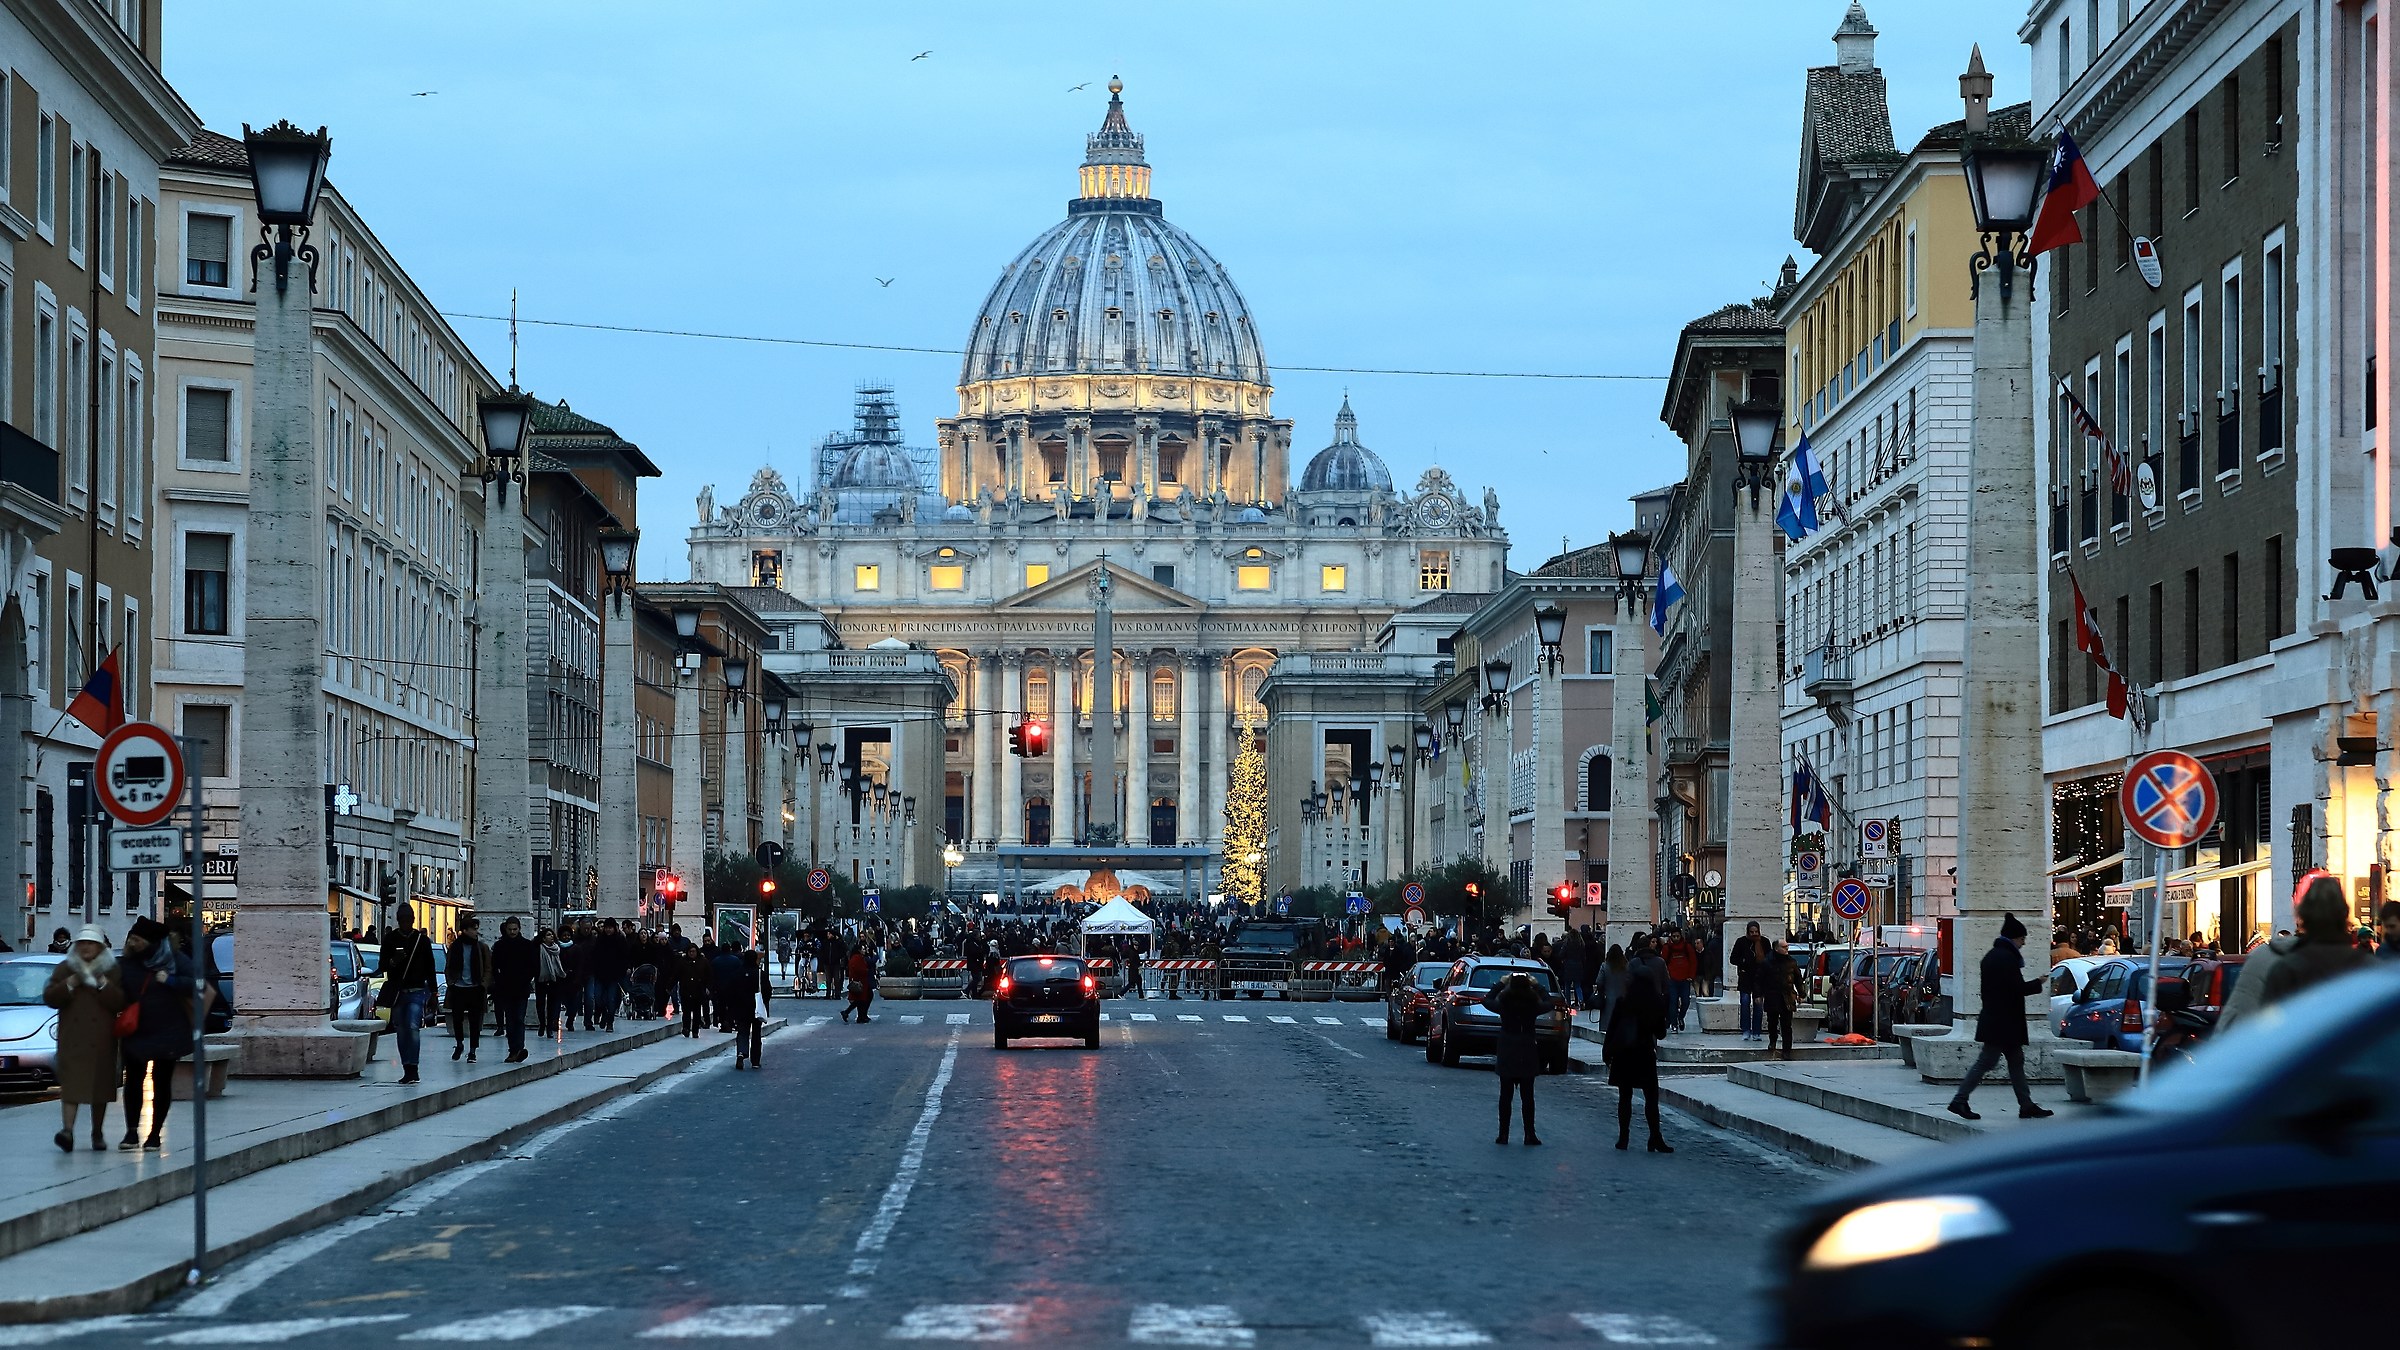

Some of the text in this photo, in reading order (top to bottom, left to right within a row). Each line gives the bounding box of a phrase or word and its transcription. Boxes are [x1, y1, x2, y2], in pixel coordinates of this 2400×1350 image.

[900, 623, 962, 632] PRINCIPIS
[964, 623, 1001, 632] APOST
[1004, 622, 1044, 631] PAVLVS
[1135, 622, 1198, 632] ROMANVS
[1332, 622, 1365, 632] PONT
[1367, 623, 1385, 632] VI
[129, 788, 152, 802] 6 m
[121, 835, 171, 849] eccetto
[131, 852, 161, 865] atac
[168, 860, 239, 874] BERIA
[215, 901, 240, 910] Editrice
